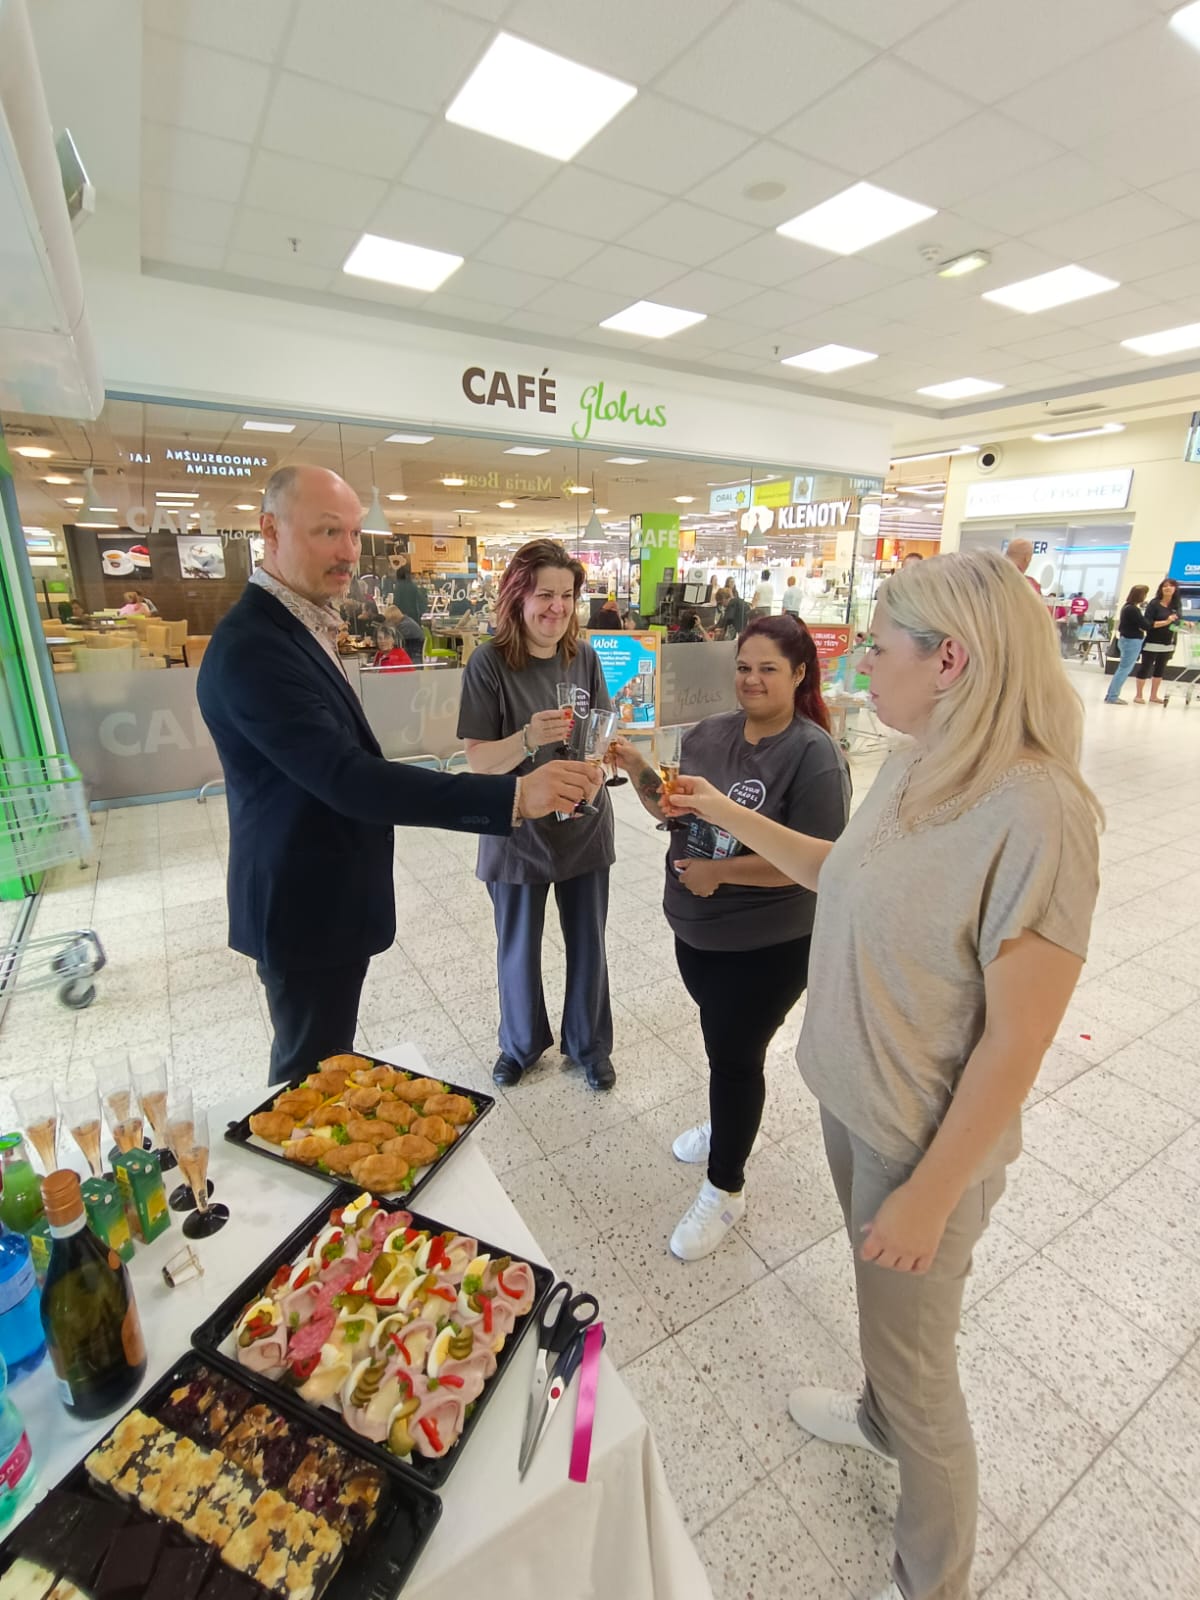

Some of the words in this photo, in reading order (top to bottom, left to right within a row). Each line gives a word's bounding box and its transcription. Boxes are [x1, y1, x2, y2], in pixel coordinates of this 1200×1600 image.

[462, 367, 557, 414] CAFÉ
[126, 502, 218, 535] CAFÉ
[778, 500, 852, 529] KLENOTY
[633, 524, 678, 549] CAFÉ
[593, 639, 618, 648] Wolt
[401, 681, 458, 744] glo
